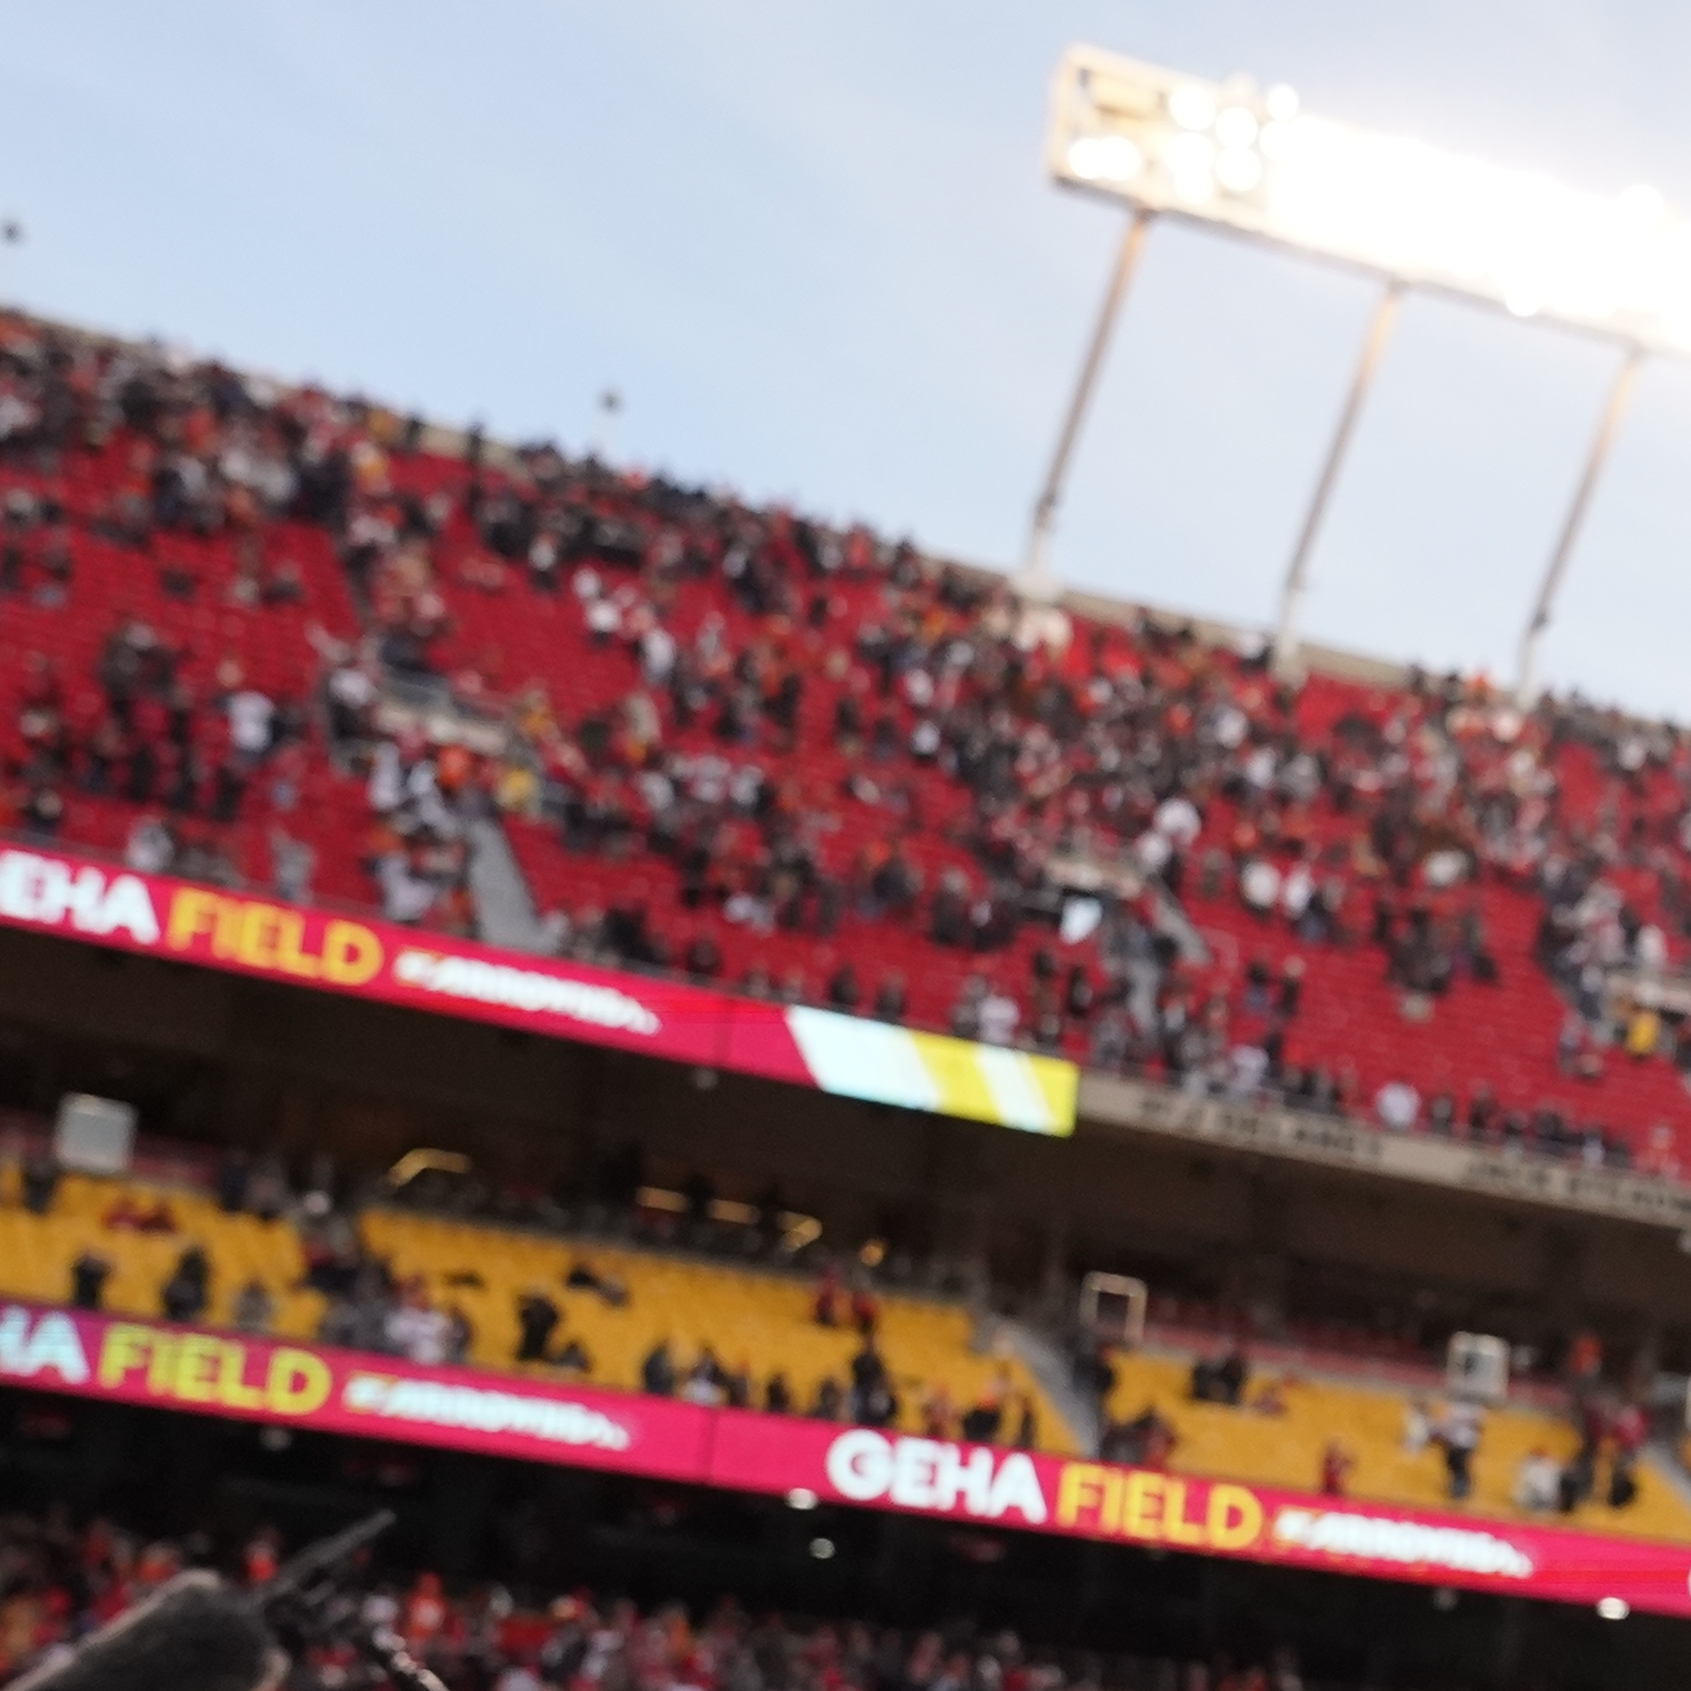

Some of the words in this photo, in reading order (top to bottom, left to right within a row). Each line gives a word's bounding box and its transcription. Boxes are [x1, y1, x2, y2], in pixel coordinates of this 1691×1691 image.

[0, 850, 159, 944] EHA
[166, 887, 384, 985] FIELD
[0, 1308, 90, 1384] HA
[101, 1323, 332, 1415] FIELD
[828, 1429, 1046, 1524] GEHA
[1058, 1463, 1263, 1550] FIELD
